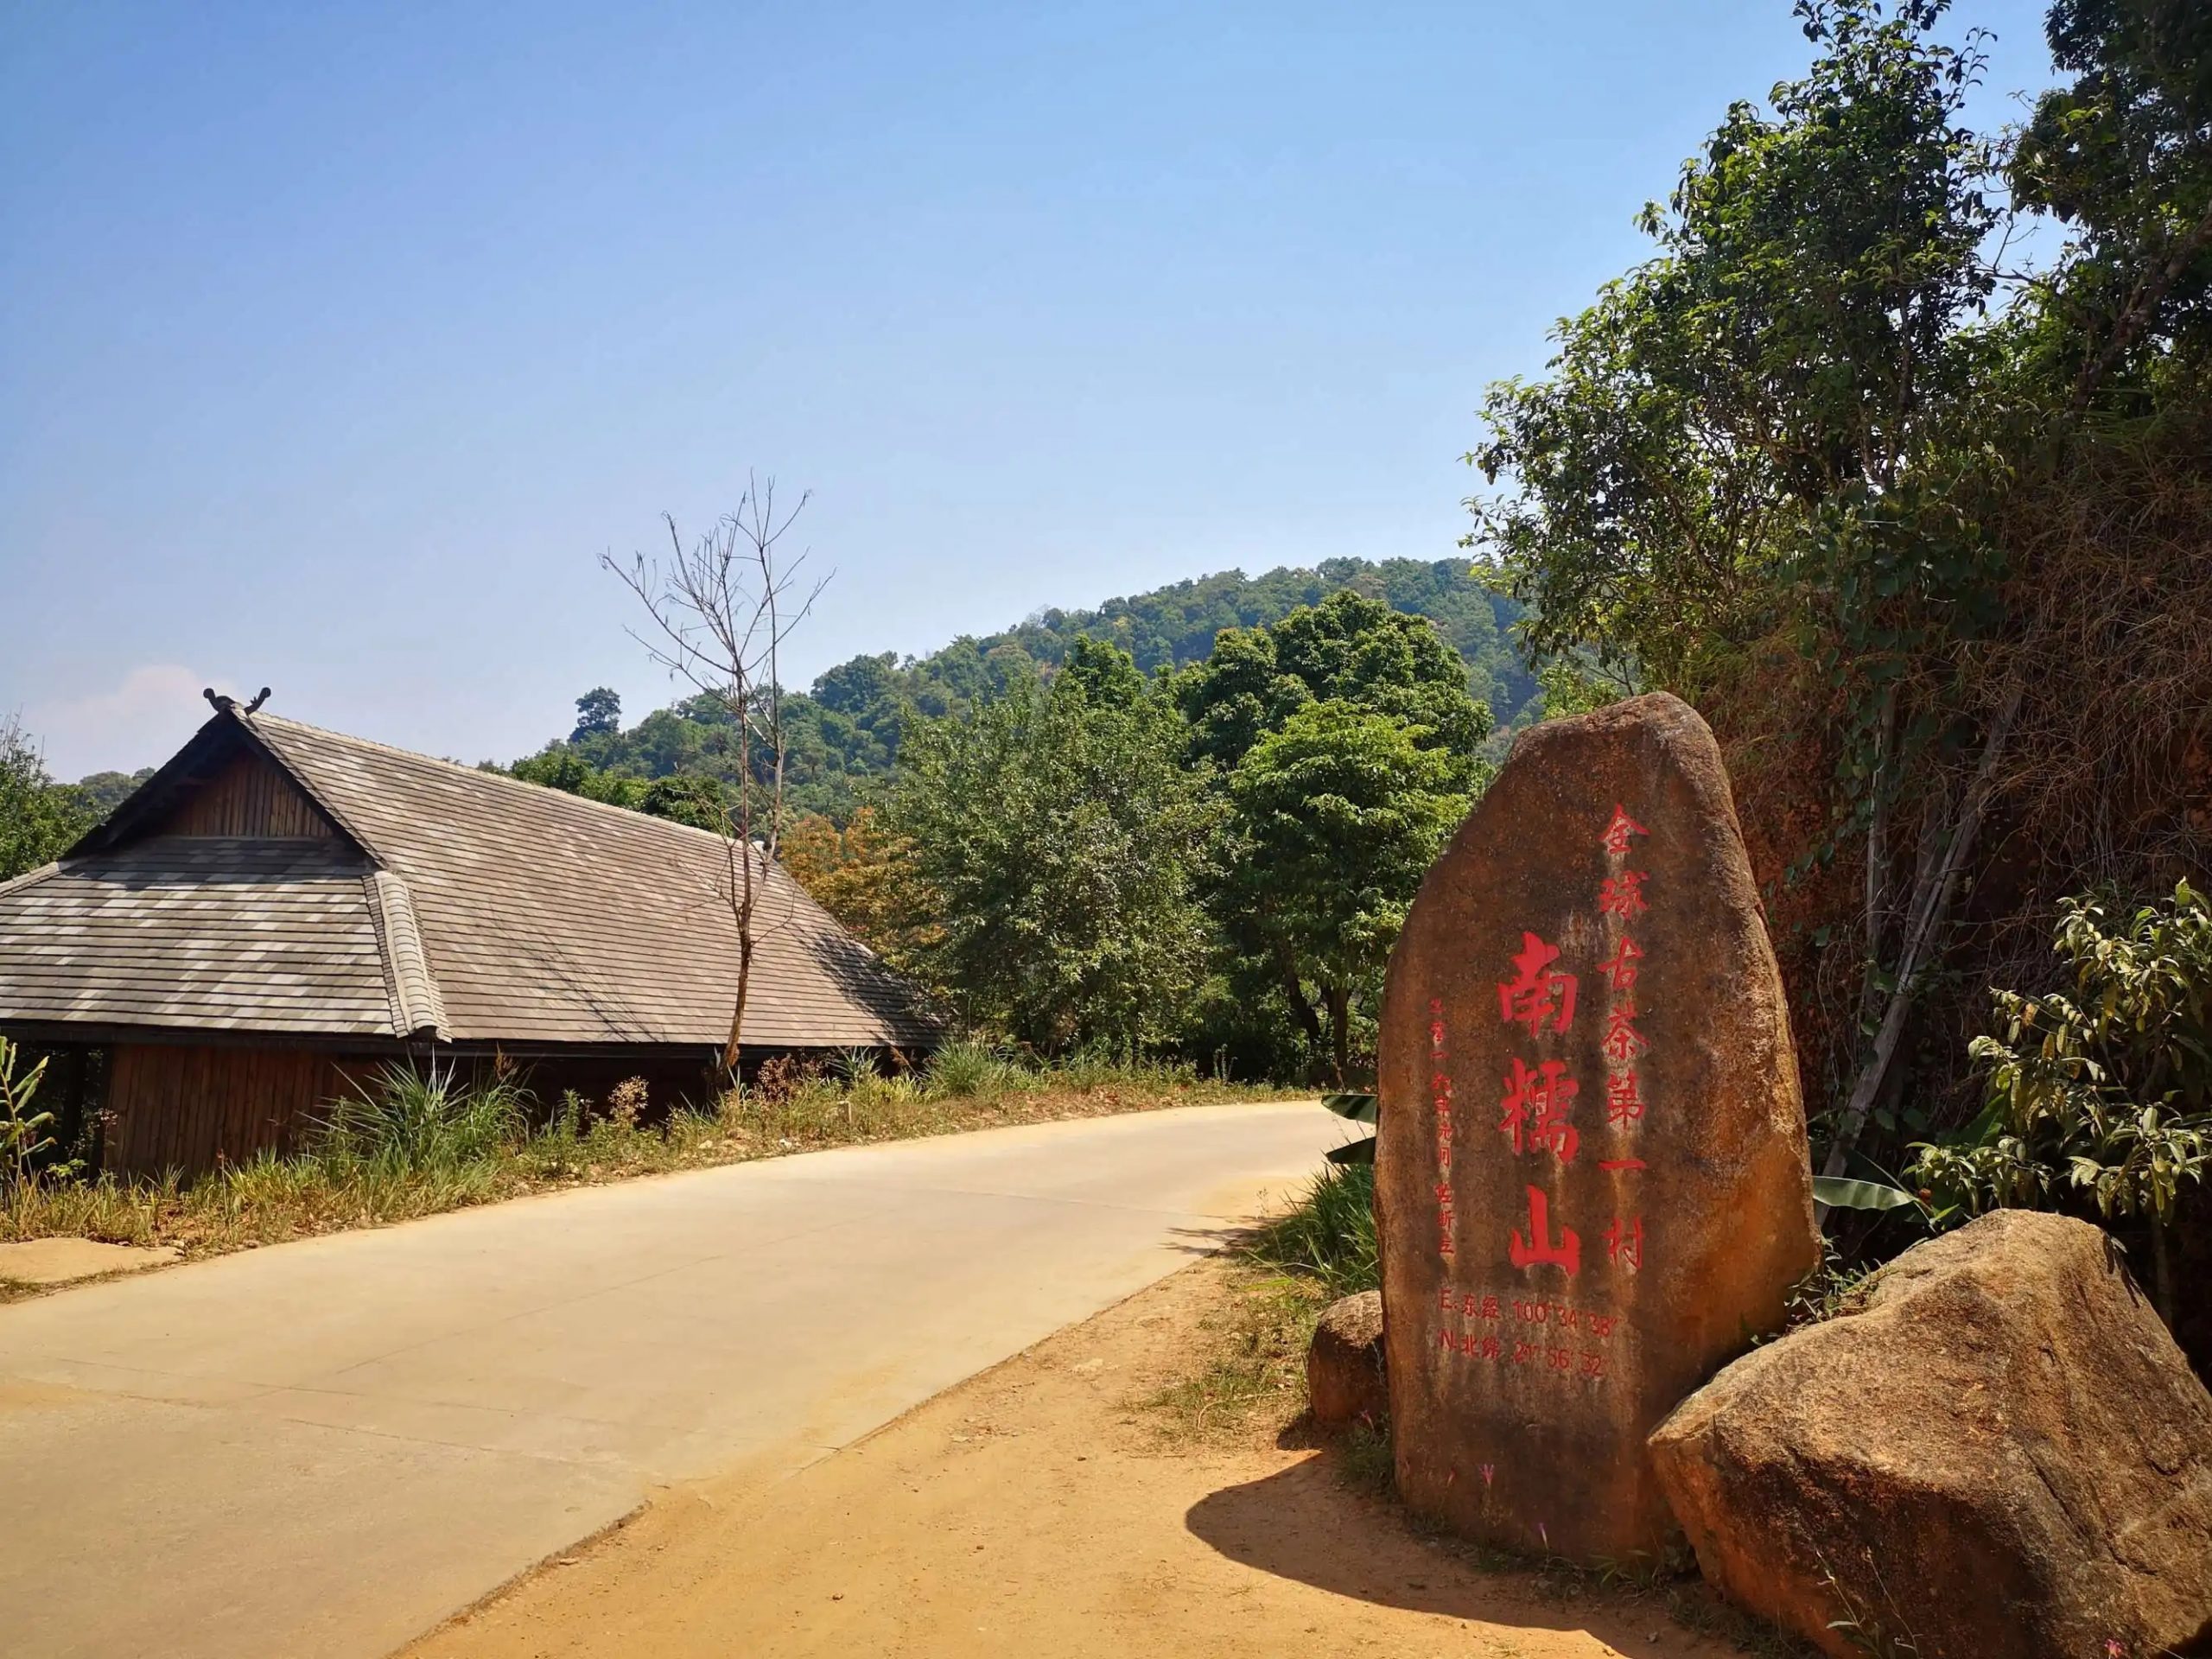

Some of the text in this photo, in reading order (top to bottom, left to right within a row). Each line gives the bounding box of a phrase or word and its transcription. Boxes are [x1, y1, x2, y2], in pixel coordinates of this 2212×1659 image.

[1497, 931, 1580, 1277] 南糯山
[1597, 804, 1650, 1269] 全球古茶第一村
